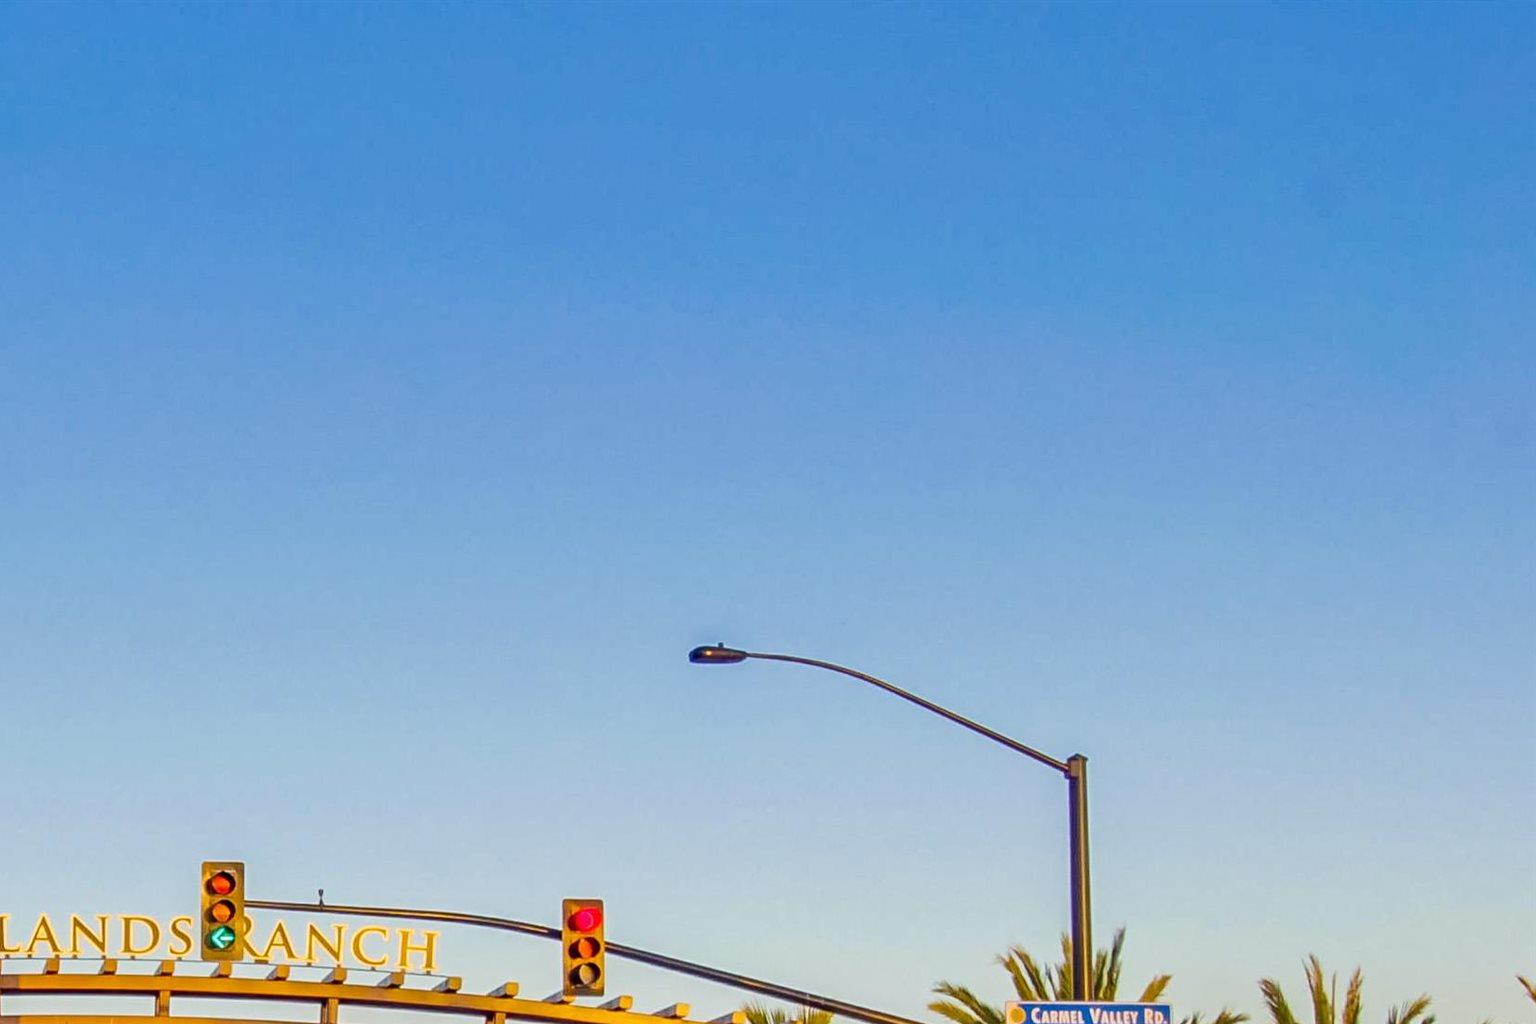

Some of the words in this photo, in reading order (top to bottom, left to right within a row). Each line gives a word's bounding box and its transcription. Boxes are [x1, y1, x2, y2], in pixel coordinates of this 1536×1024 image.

[1031, 1007, 1085, 1024] CARMEL
[1089, 1007, 1138, 1024] VALLEY
[1144, 1008, 1168, 1024] RD.
